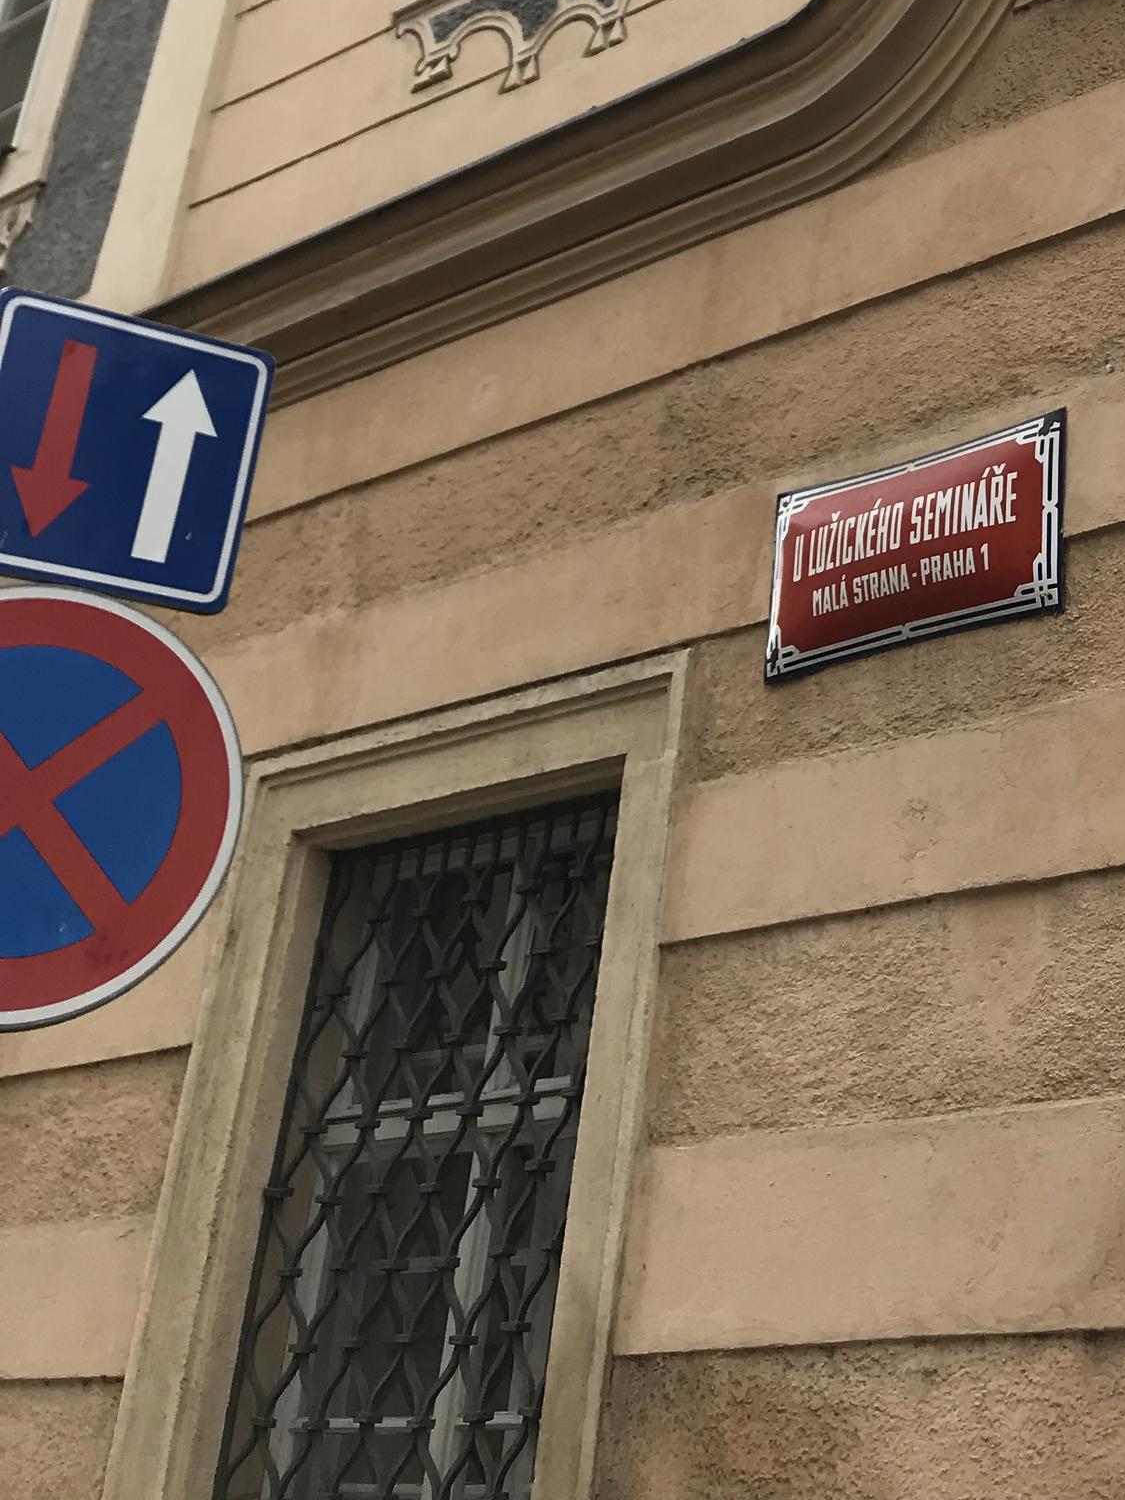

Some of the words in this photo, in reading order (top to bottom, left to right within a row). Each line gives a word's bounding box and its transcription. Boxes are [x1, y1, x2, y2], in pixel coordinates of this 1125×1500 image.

[793, 534, 804, 582] U
[808, 498, 905, 576] LUŽICKÉHO
[909, 463, 1018, 545] SEMINÁŘE
[812, 573, 849, 617] MALÁ
[853, 563, 910, 604] STRANA
[920, 547, 976, 586] PRAHA
[980, 543, 990, 570] 1
